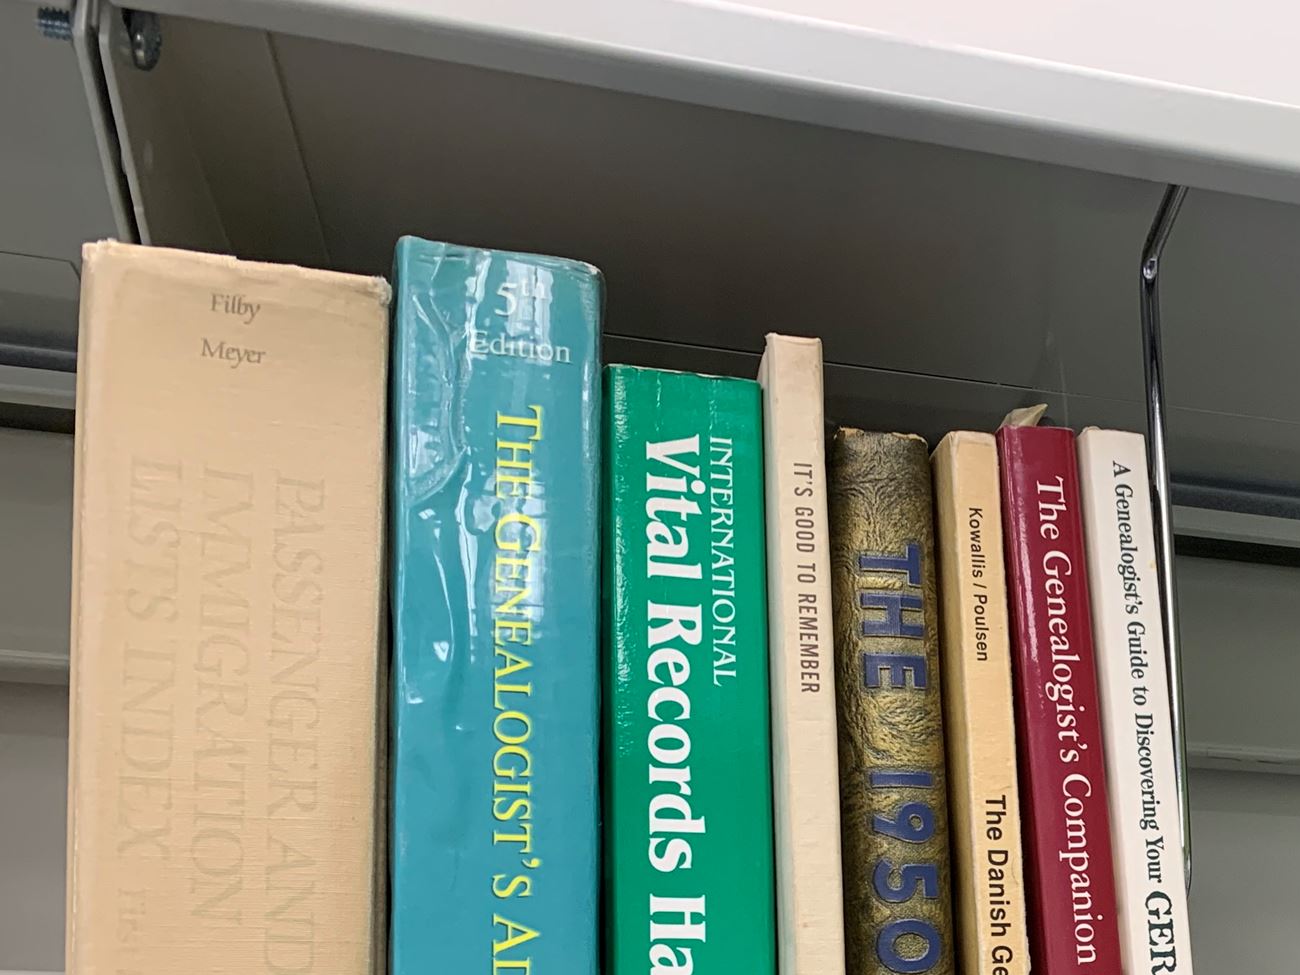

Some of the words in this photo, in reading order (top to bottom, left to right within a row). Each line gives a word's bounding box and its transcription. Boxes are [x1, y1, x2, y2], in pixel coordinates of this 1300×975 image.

[200, 338, 266, 367] Meyer
[211, 293, 260, 324] Filby
[470, 330, 572, 364] Edition
[495, 405, 543, 503] THE
[793, 462, 813, 498] IT'S
[1113, 460, 1131, 477] A
[124, 456, 183, 623] LISTS
[645, 434, 706, 580] Vital
[795, 506, 815, 554] GOOD
[968, 507, 984, 578] Kowallis
[1036, 475, 1066, 539] The
[1114, 484, 1139, 615] Genealogist's
[710, 436, 737, 687] INTERNATIONAL
[797, 562, 816, 584] TO
[265, 468, 325, 824] PASSENGER
[798, 593, 821, 694] REMEMBER
[859, 543, 928, 690] THE
[974, 594, 990, 662] Poulsen
[1043, 550, 1088, 763] Genealogist's
[1126, 621, 1146, 679] Guide
[191, 462, 255, 925] IMMIGRATION
[492, 514, 542, 898] GENEALOGIST'S
[647, 599, 706, 872] Records
[1133, 685, 1147, 706] to
[116, 640, 177, 860] INDEX
[1134, 713, 1162, 831] Discovering
[985, 794, 1007, 841] The
[1145, 837, 1163, 884] Your
[263, 830, 316, 975] AND
[870, 771, 942, 975] 1950
[987, 850, 1012, 937] Danish
[1059, 774, 1103, 965] Companion
